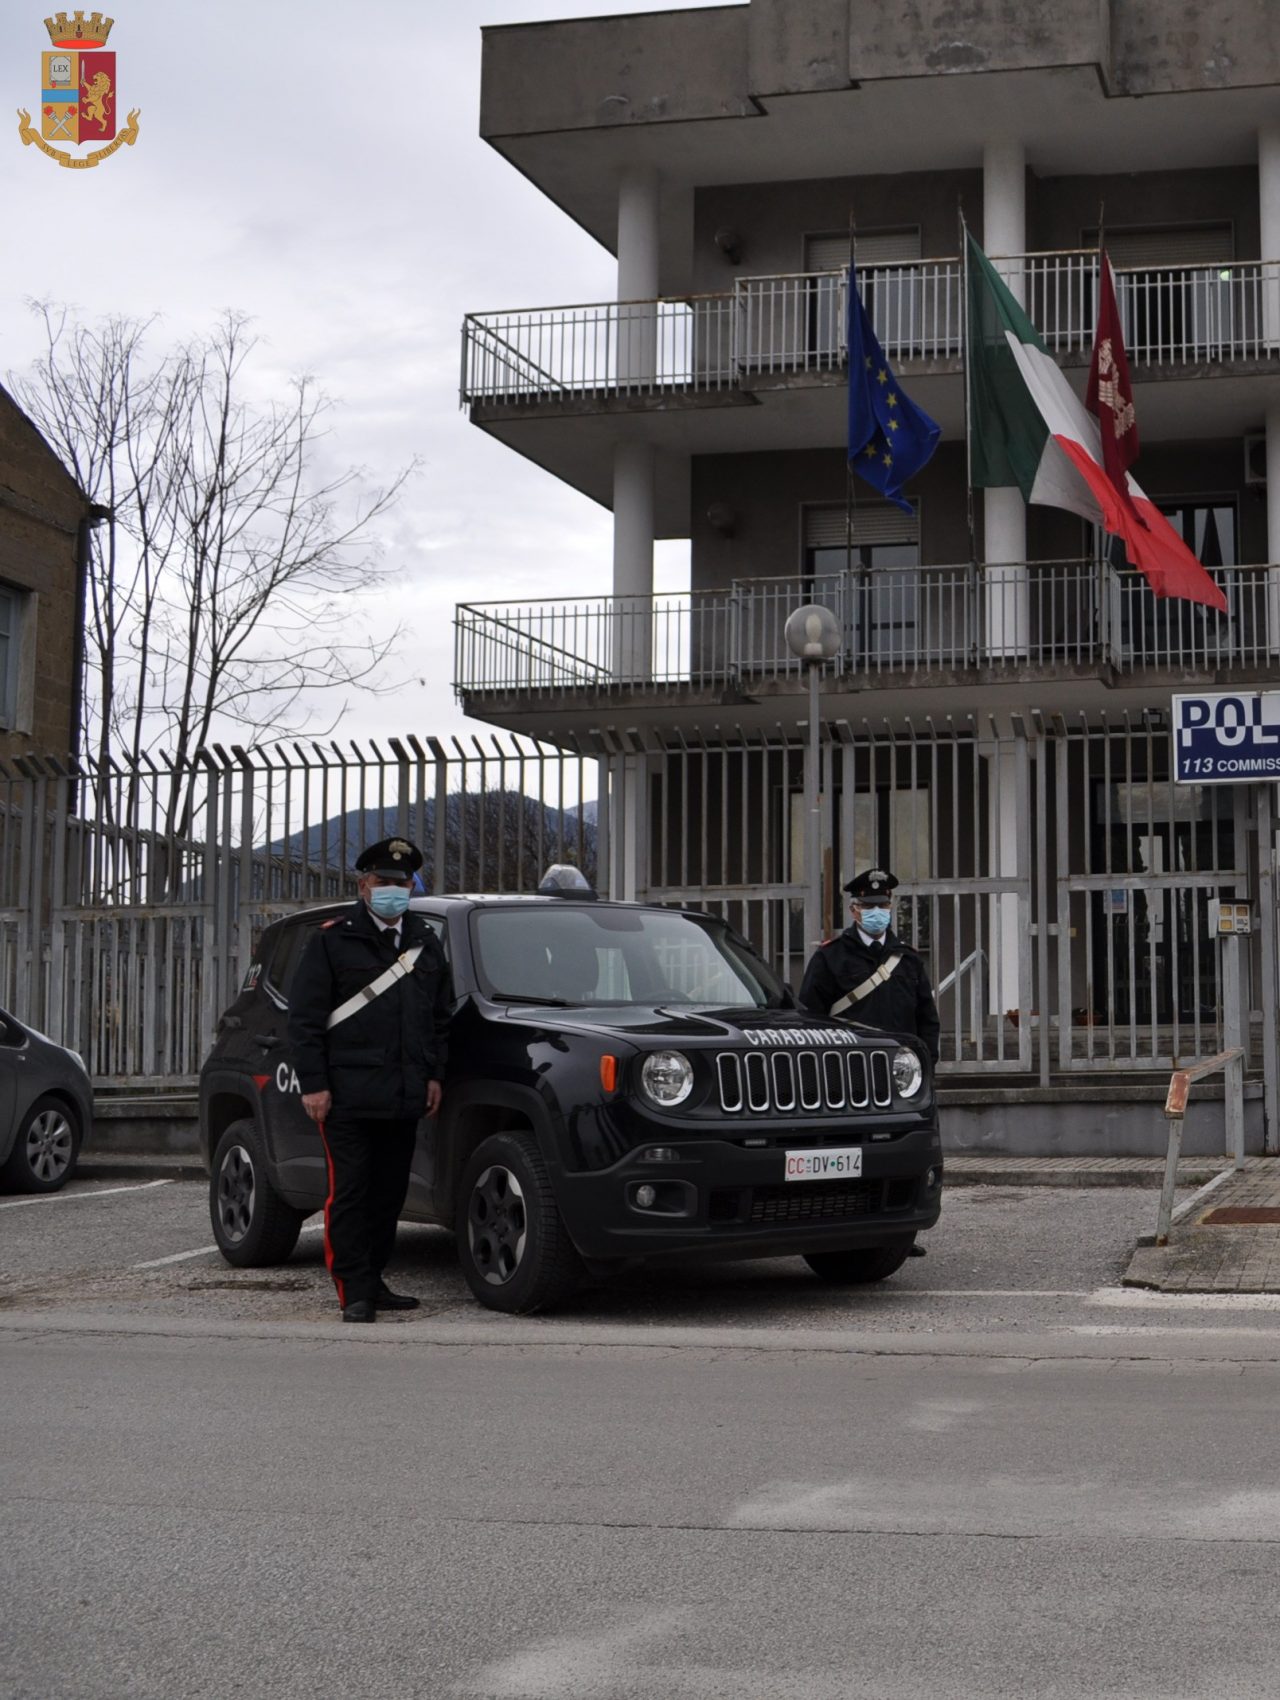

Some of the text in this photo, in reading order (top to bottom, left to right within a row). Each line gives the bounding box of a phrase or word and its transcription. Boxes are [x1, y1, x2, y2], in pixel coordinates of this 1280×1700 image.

[1182, 757, 1214, 774] 113
[743, 1028, 858, 1046] CARABINIERI
[787, 1154, 861, 1175] CC DV 614
